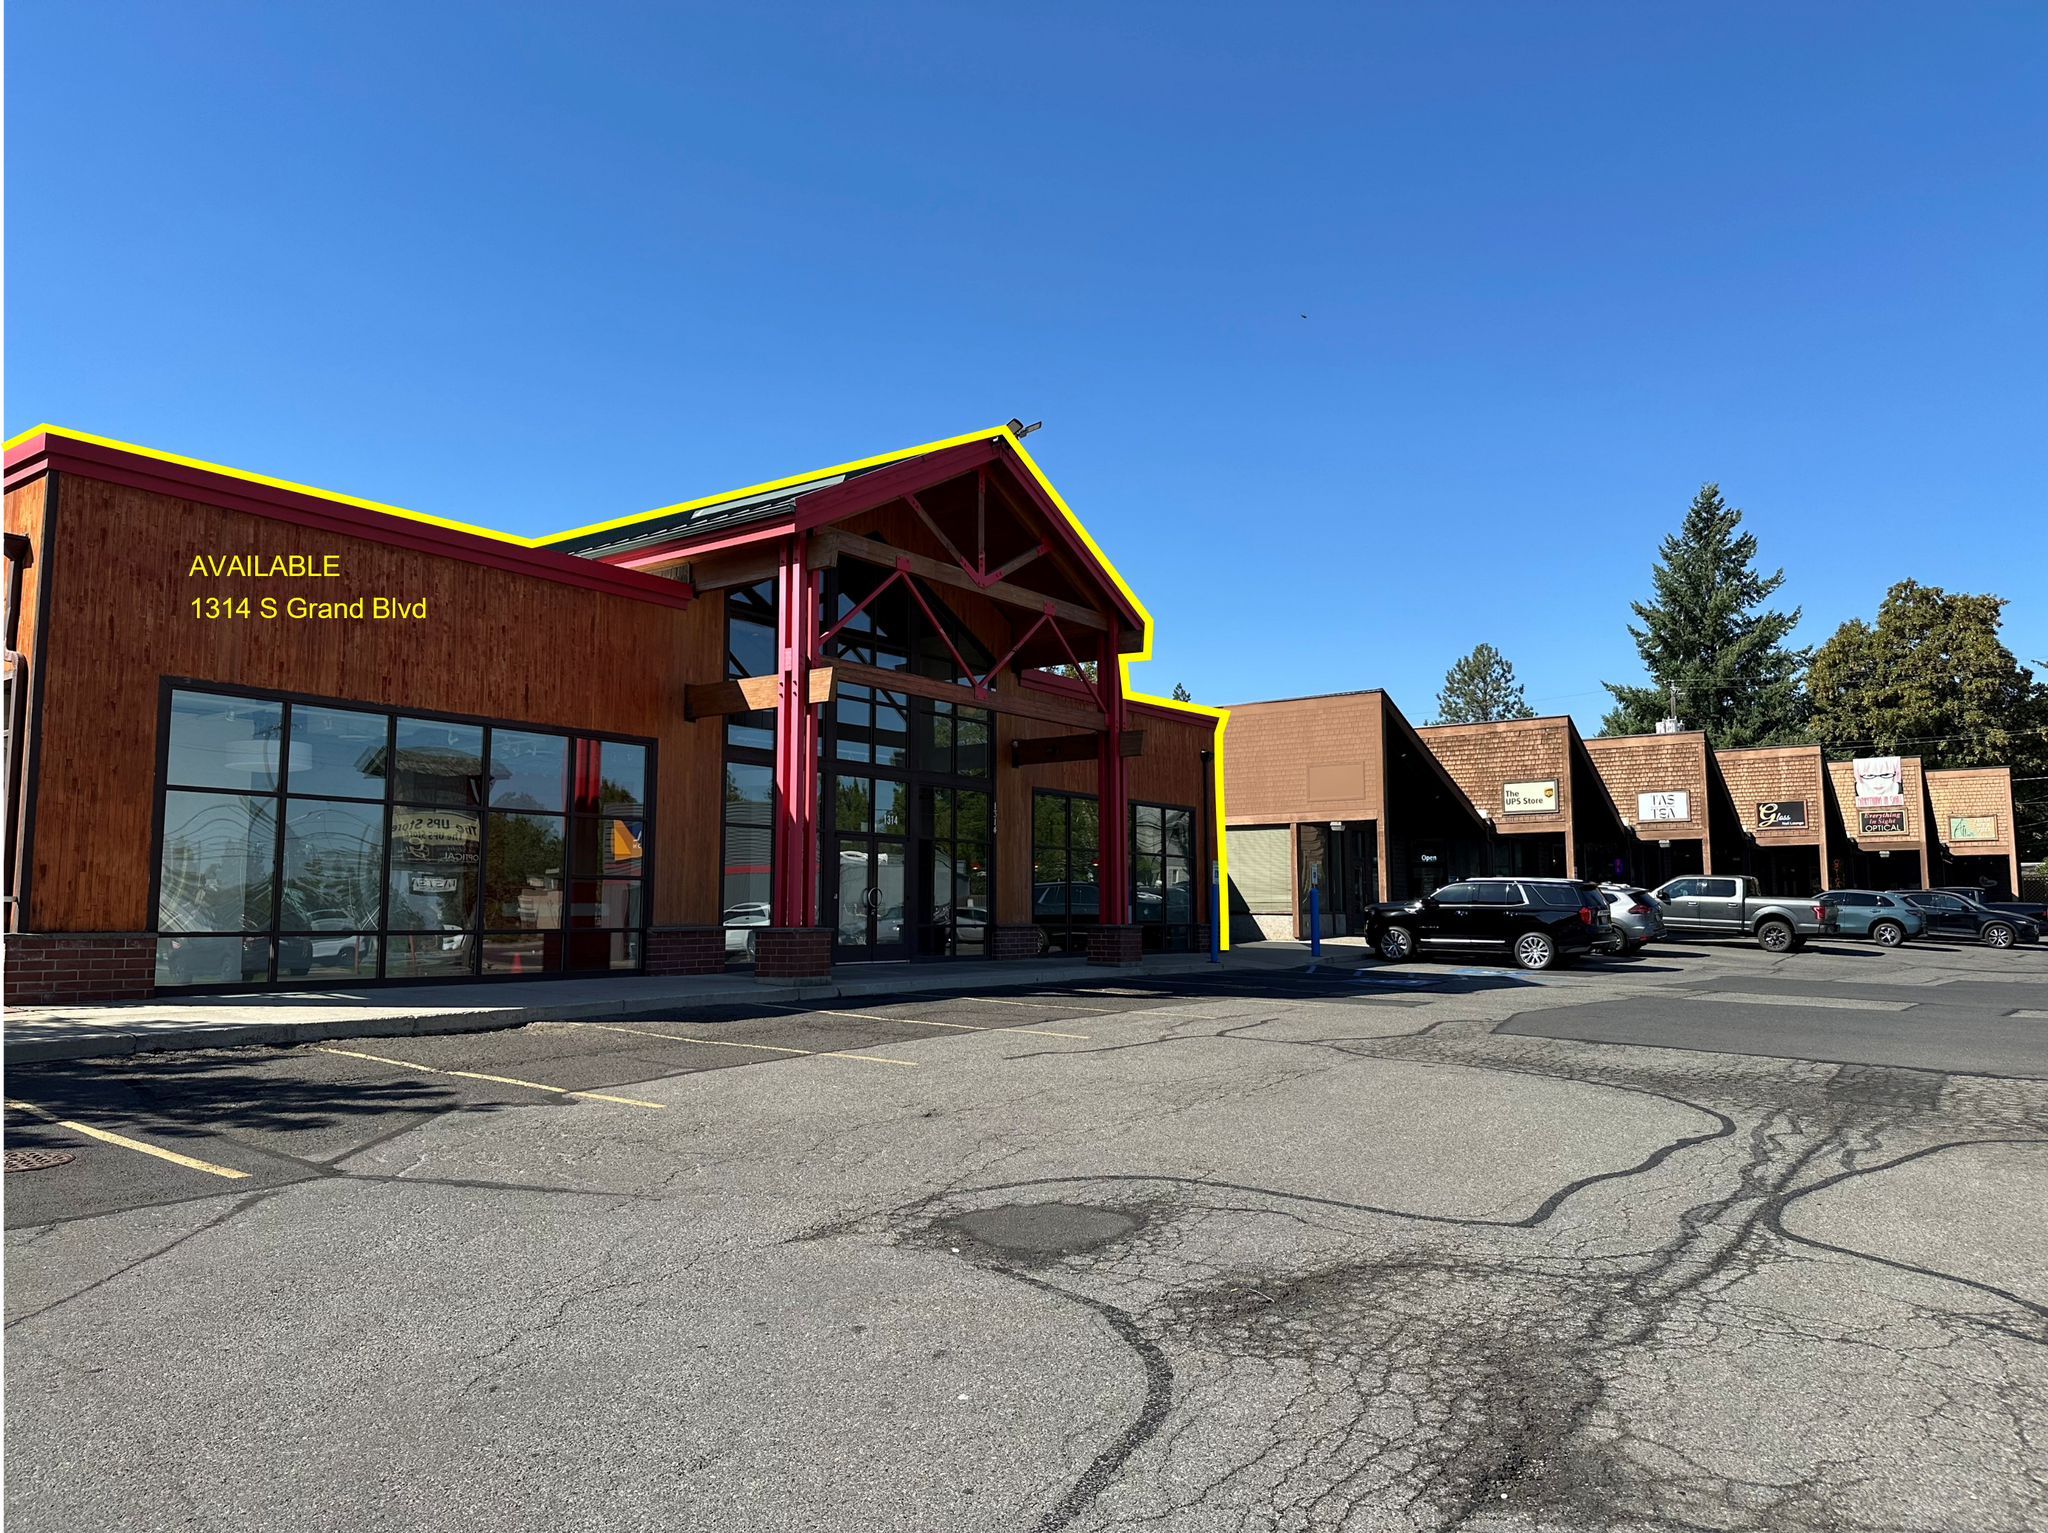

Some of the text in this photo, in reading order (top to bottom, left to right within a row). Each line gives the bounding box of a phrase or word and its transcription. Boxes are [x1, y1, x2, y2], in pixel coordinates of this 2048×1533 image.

[1505, 797, 1544, 806] UPS Store
[883, 814, 898, 825] 1314
[1864, 824, 1901, 832] OPTICAL
[1421, 854, 1437, 862] Open
